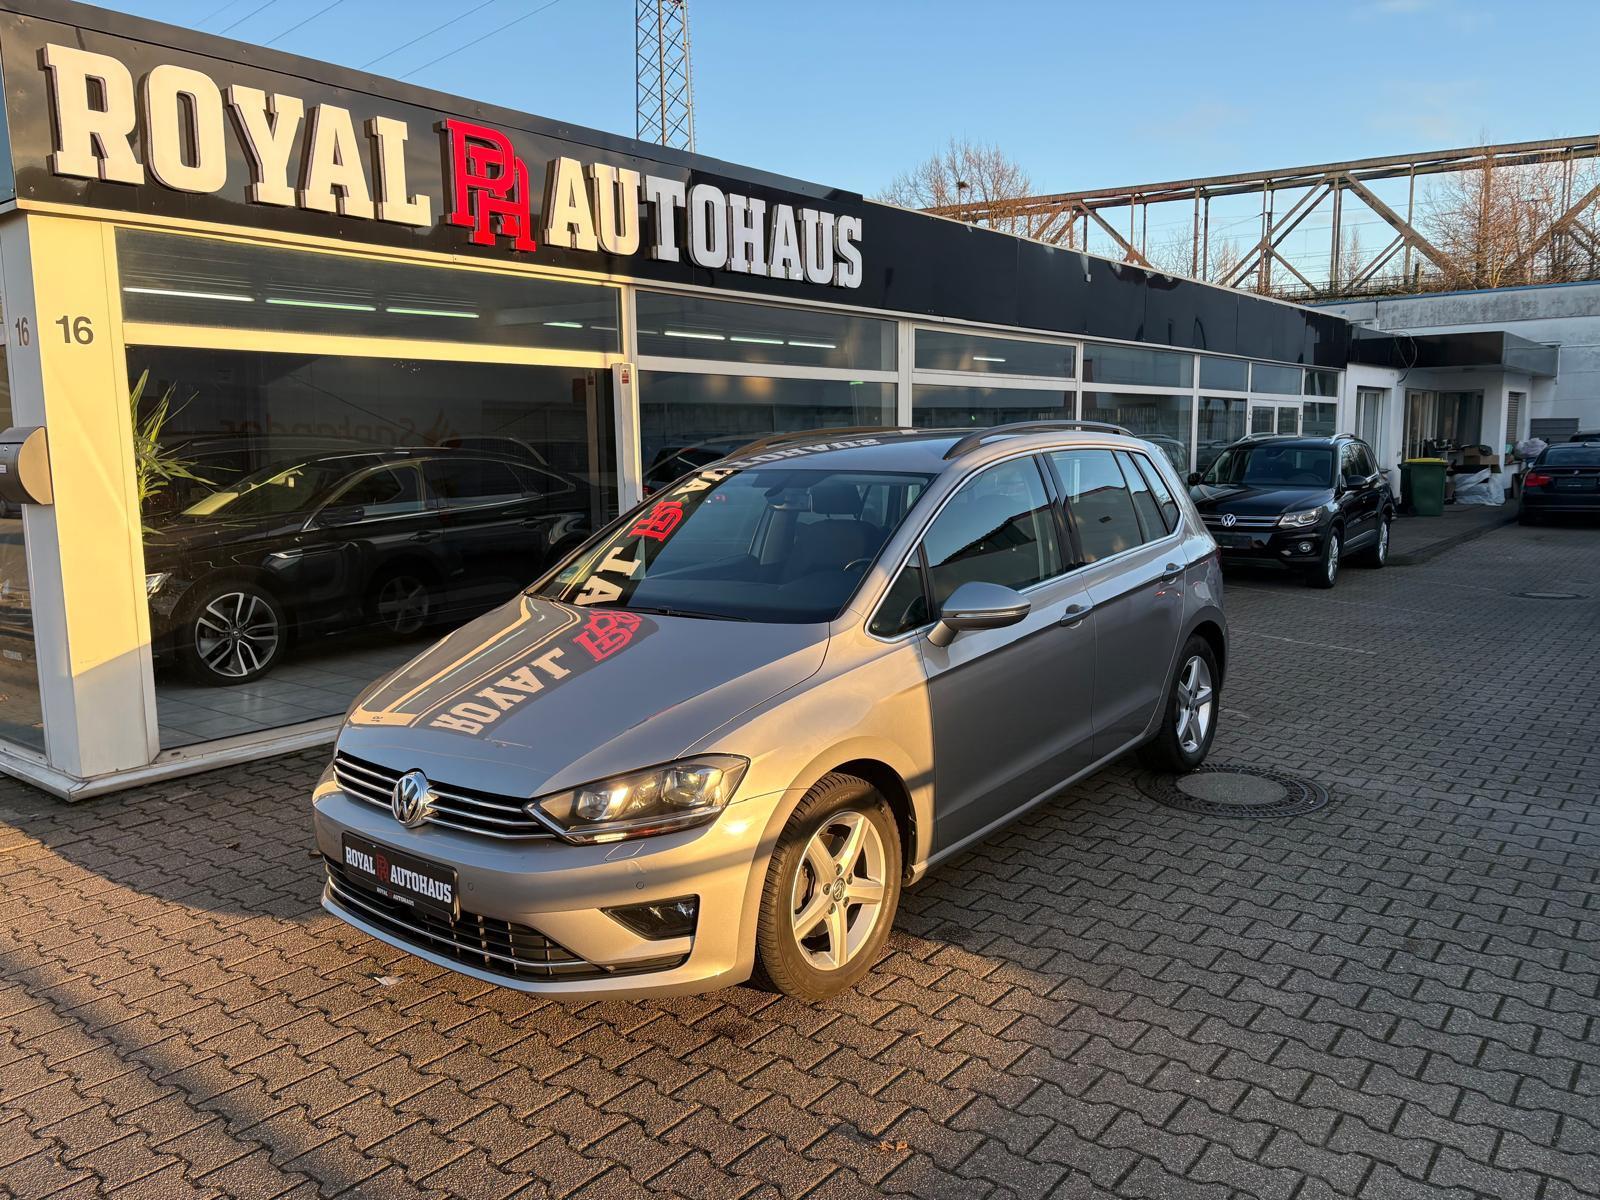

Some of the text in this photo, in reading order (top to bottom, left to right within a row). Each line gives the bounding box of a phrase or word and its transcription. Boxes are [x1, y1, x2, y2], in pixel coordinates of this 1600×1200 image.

[41, 43, 431, 228] ROYAL
[546, 156, 863, 289] AUTOHAUS
[15, 316, 30, 346] 16
[55, 315, 94, 345] 16
[345, 846, 376, 875] ROYAL
[390, 865, 452, 904] AUTOHAUS
